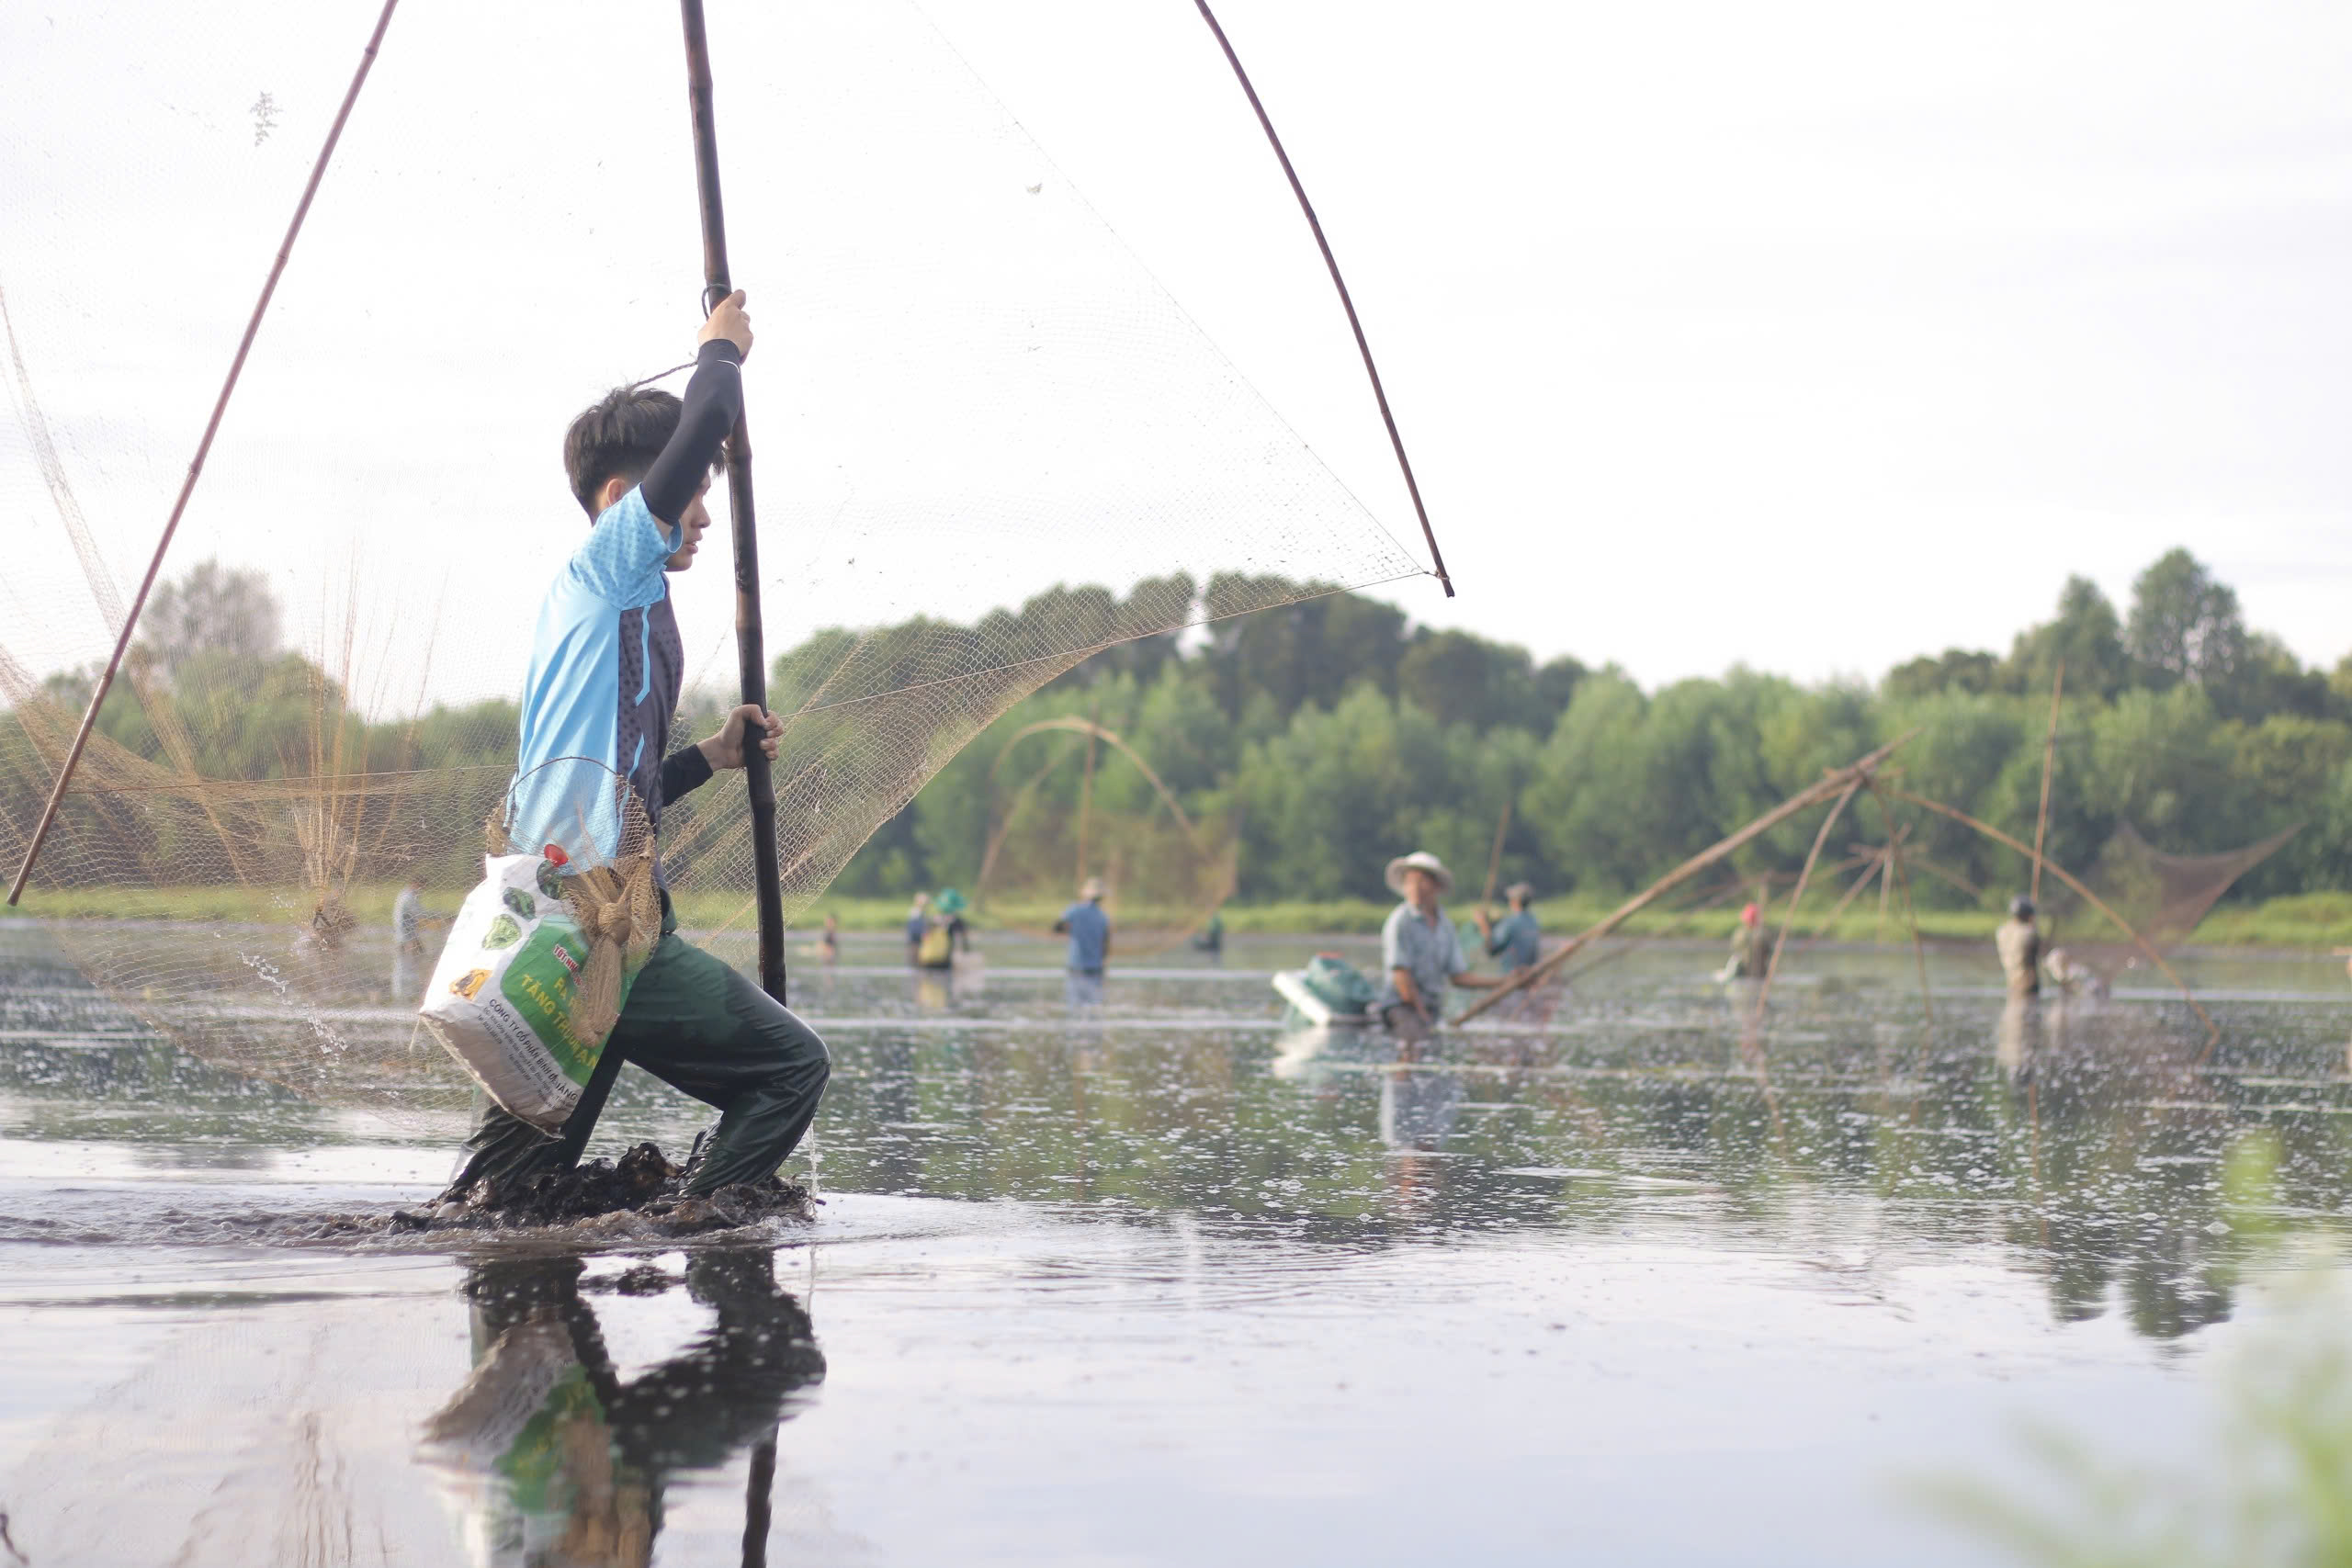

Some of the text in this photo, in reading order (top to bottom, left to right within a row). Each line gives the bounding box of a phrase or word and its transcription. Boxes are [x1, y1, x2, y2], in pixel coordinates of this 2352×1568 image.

[521, 975, 556, 1015] TĂNG
[489, 998, 511, 1022] CÔNG
[508, 1020, 520, 1032] TY
